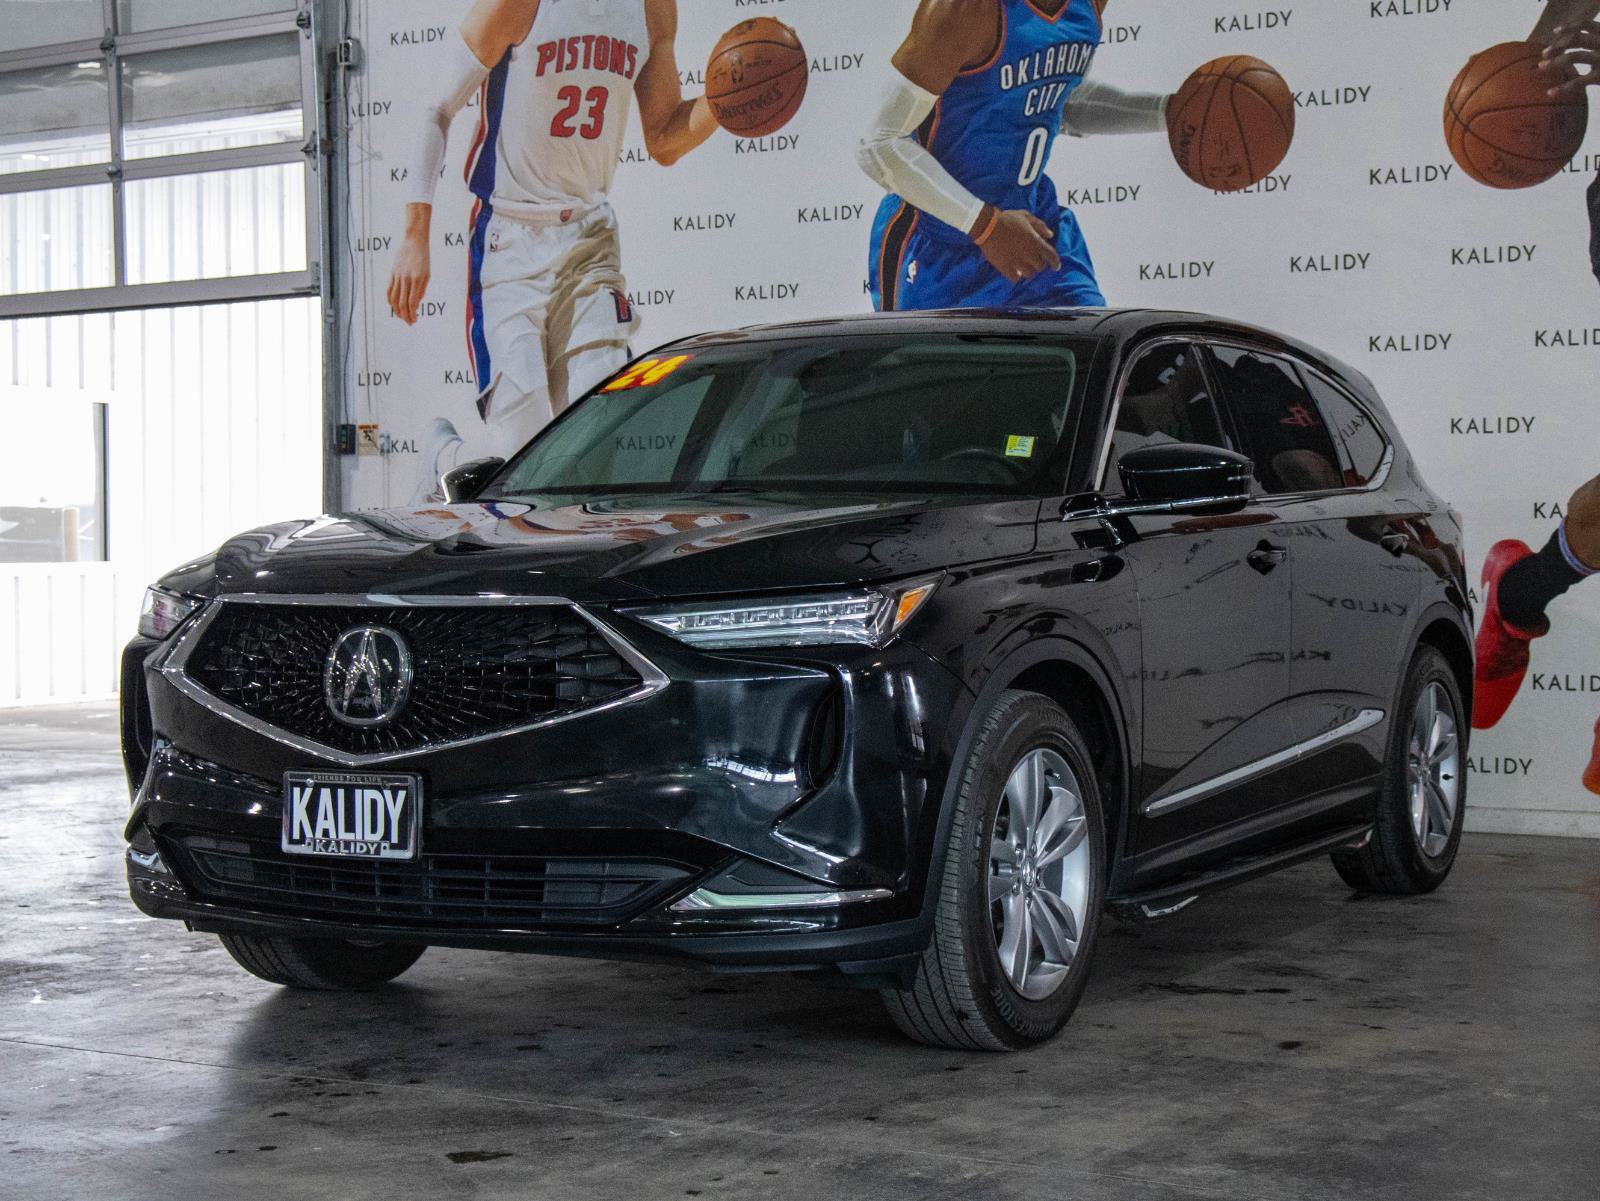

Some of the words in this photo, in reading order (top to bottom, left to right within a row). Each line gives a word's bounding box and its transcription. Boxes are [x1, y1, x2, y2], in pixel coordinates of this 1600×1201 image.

[1370, 0, 1451, 18] KALIDY
[1214, 10, 1293, 33] KALIDY
[390, 26, 447, 46] KALIDY
[535, 34, 639, 80] PISTONS
[810, 53, 865, 73] ALIDY
[1000, 42, 1094, 91] OKLAHOM
[1024, 82, 1068, 117] CITY
[1292, 85, 1372, 108] KALIDY
[351, 100, 392, 118] LIDY
[550, 85, 609, 140] 23
[735, 134, 800, 154] KALIDY
[1017, 127, 1049, 187] 0
[1369, 164, 1453, 185] KALIDY
[1067, 185, 1141, 205] KALIDY
[673, 213, 736, 232] KALIDY
[798, 204, 864, 224] KALIDY
[357, 236, 392, 252] LIDY
[1289, 252, 1371, 273] KALIDY
[1450, 244, 1537, 266] KALIDY
[1139, 260, 1215, 281] KALIDY
[627, 289, 675, 306] ALIDY
[735, 283, 800, 301] KALIDY
[1368, 333, 1453, 352] KALIDY
[357, 371, 392, 387] LIDY
[444, 369, 474, 385] KAL
[1450, 416, 1536, 435] KALIDY
[391, 439, 420, 454] KAL
[615, 434, 677, 450] KALIDY
[1532, 673, 1600, 692] KALID
[1466, 756, 1533, 776] ALIDY
[292, 786, 407, 844] KALIDY
[315, 840, 378, 855] KALIDY
